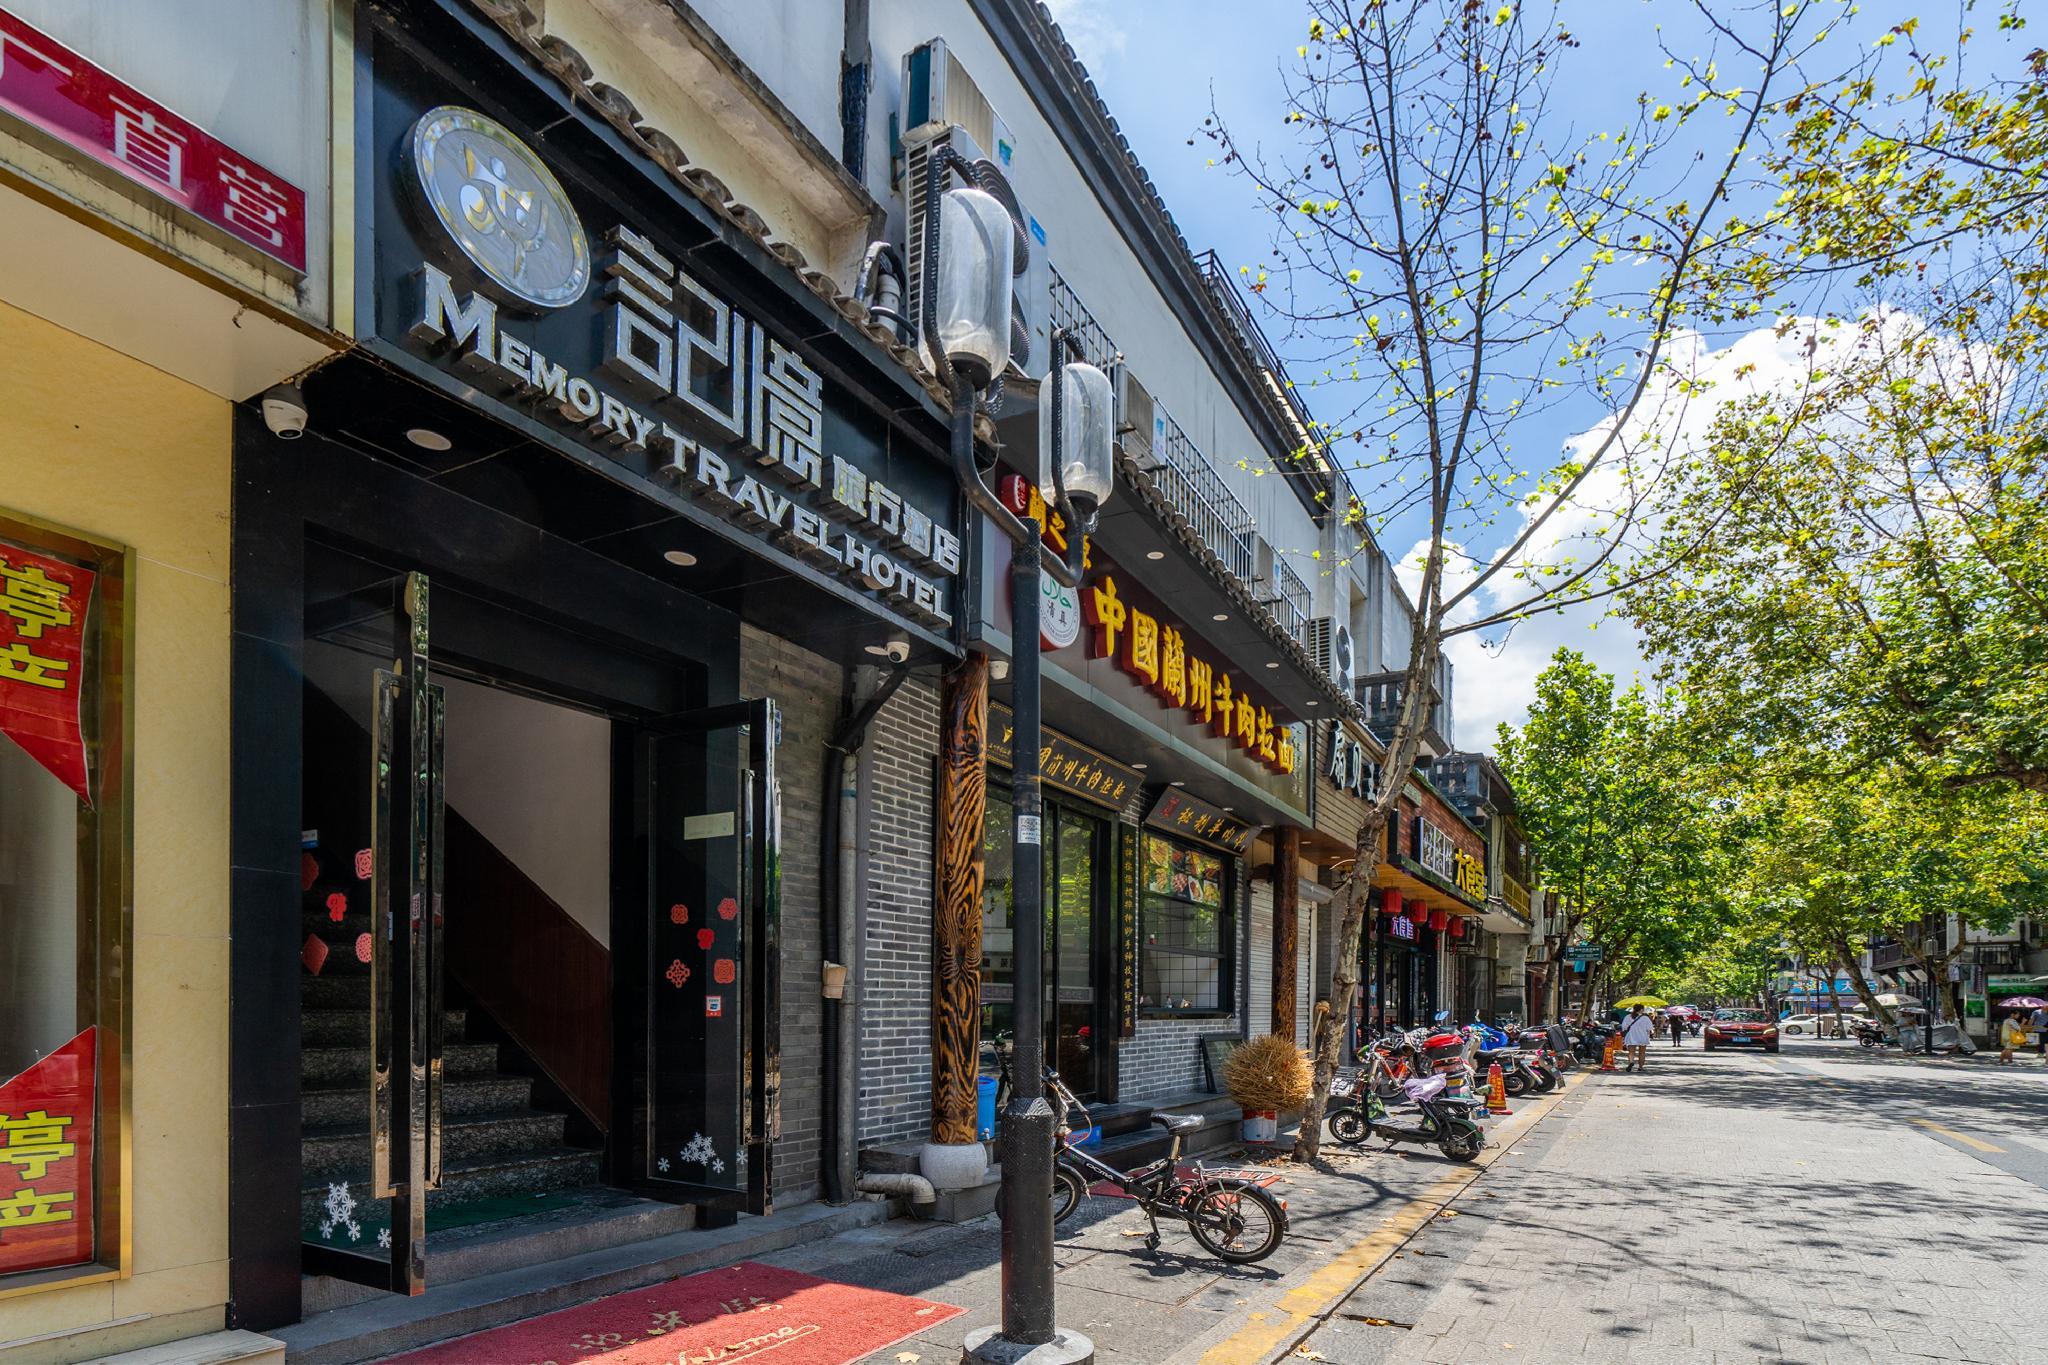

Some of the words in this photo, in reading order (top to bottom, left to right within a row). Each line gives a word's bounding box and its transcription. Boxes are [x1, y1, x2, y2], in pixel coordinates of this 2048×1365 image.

[422, 261, 656, 450] MEMORY
[662, 422, 843, 560] TRAVEL
[845, 532, 953, 627] HOTEL
[832, 453, 961, 576] 旅行酒店
[530, 1296, 784, 1365] 迎光临
